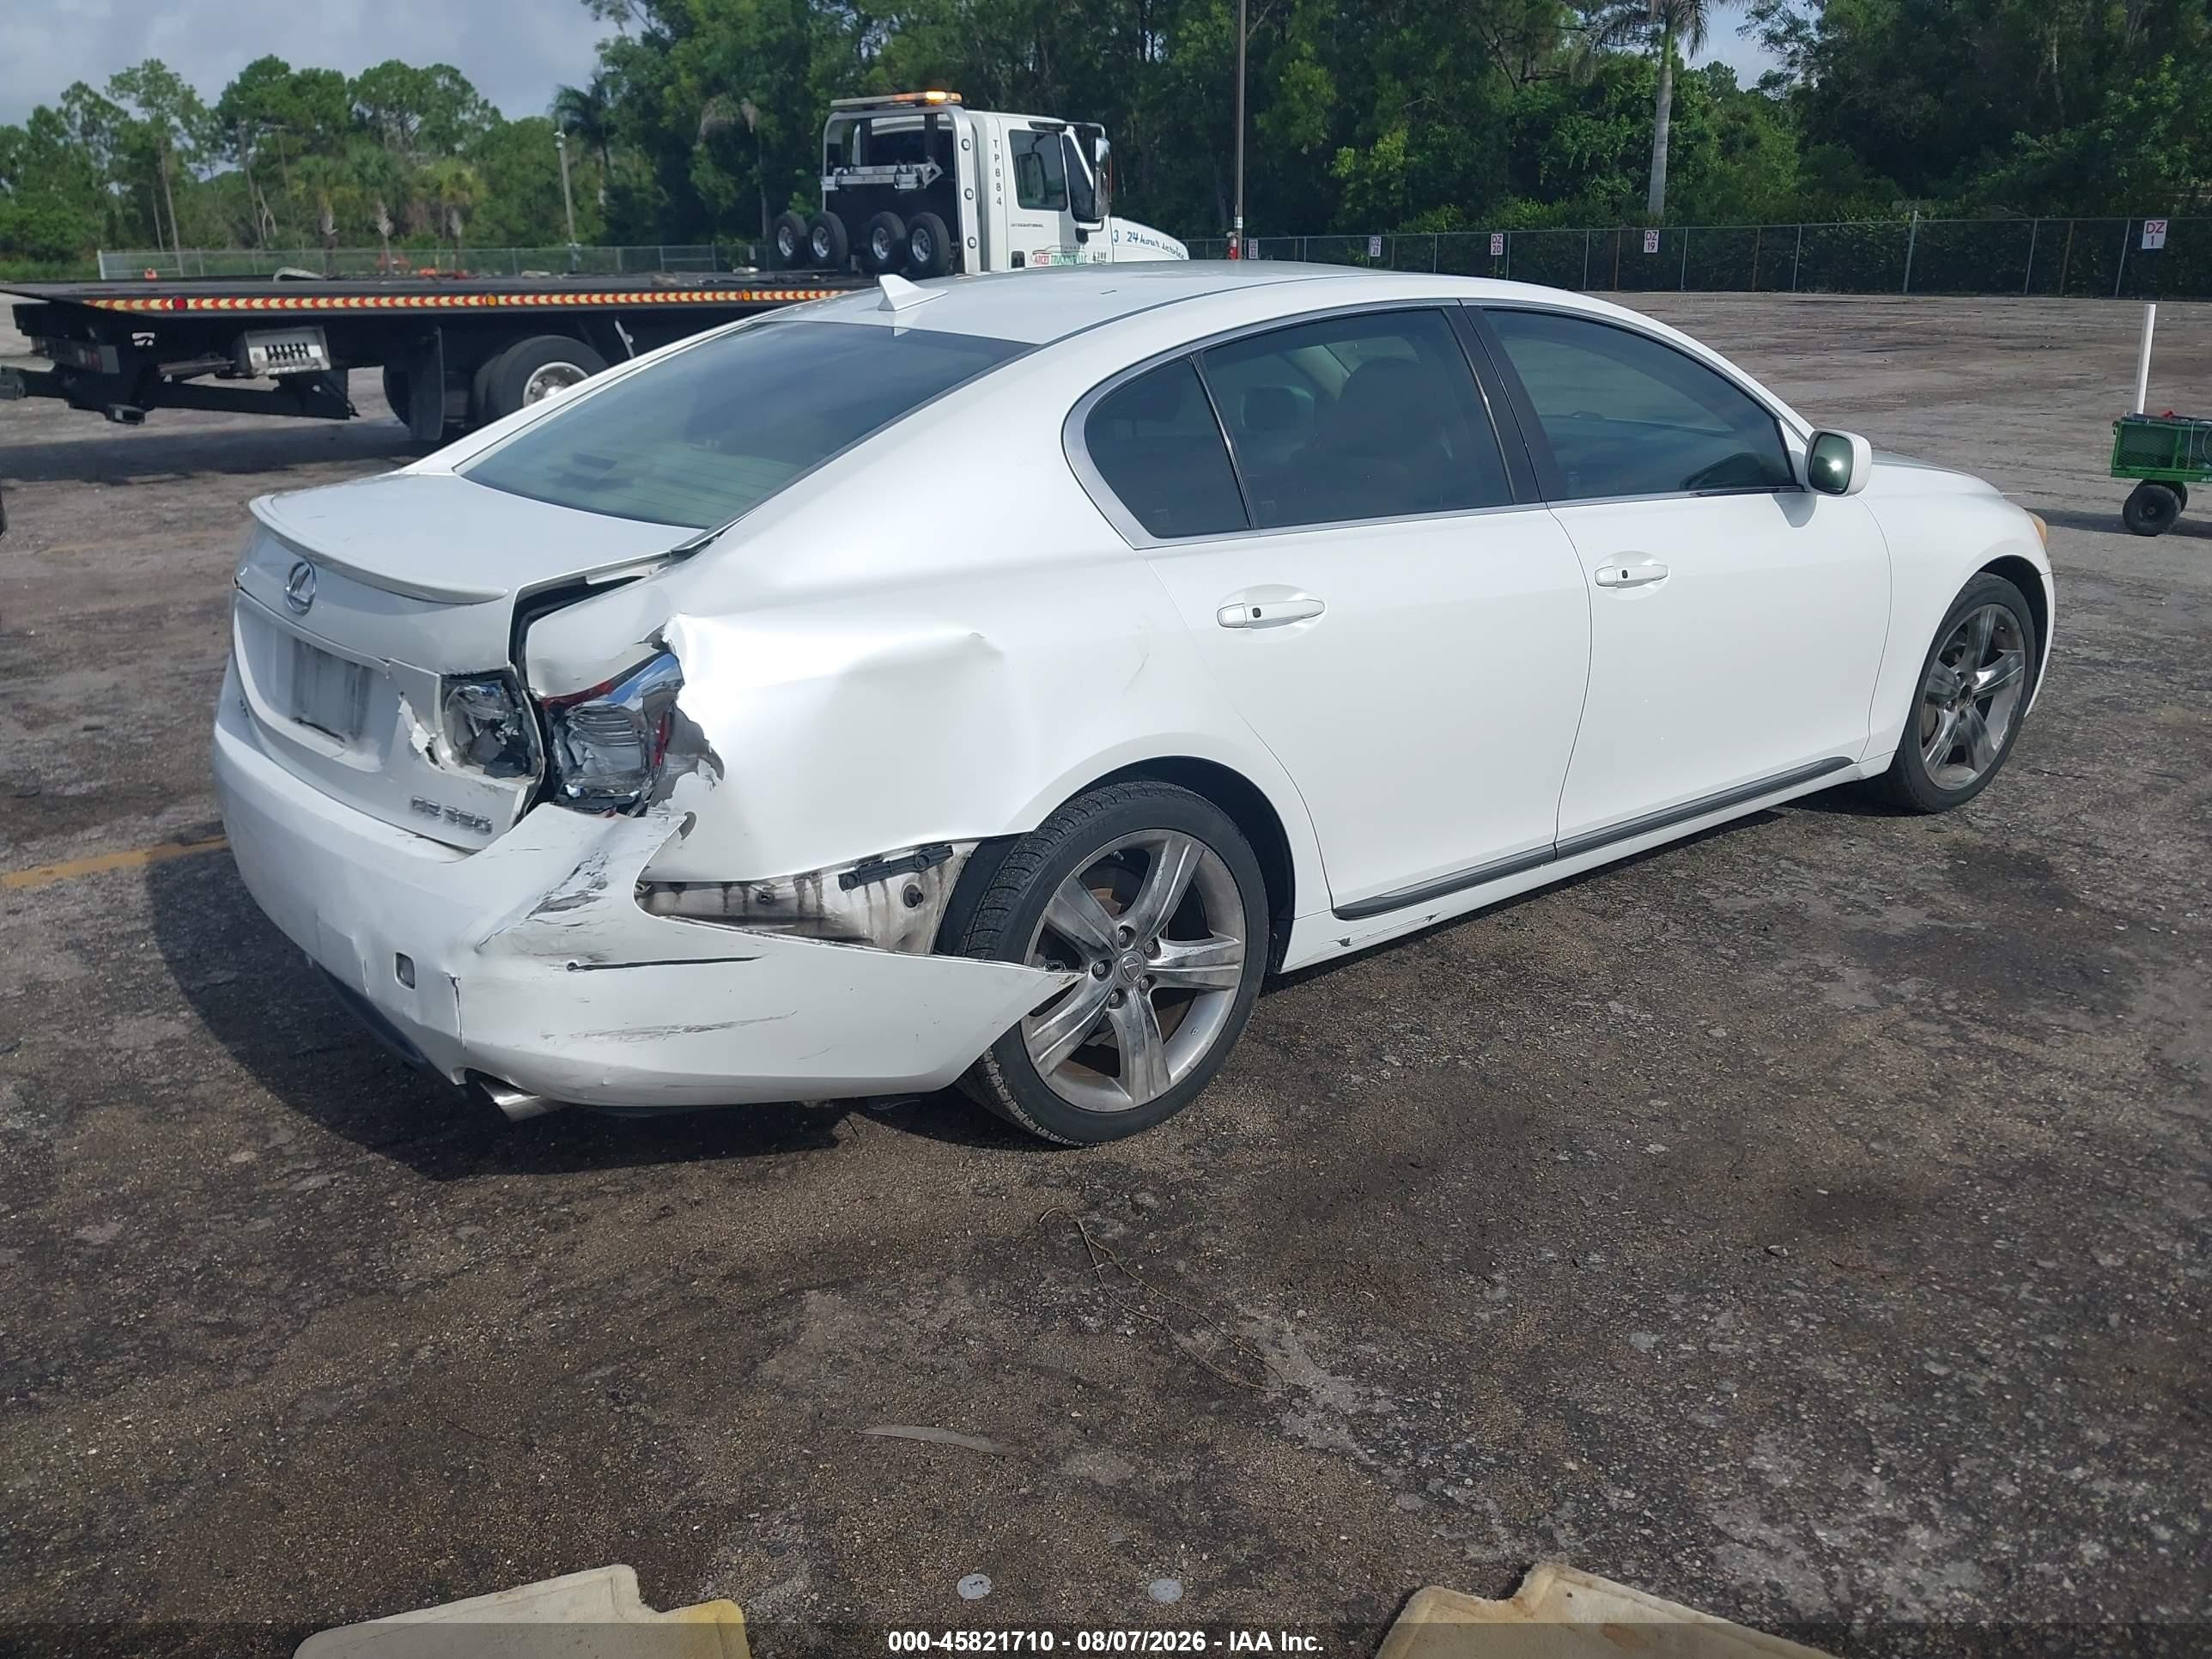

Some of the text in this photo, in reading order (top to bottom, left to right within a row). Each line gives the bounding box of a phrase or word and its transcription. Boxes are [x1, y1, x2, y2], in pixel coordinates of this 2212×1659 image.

[2146, 222, 2166, 234] DZ
[1127, 230, 1139, 243] 24
[1139, 234, 1160, 247] hour
[1492, 235, 1503, 244] DZ
[1646, 231, 1658, 241] DZ
[2150, 235, 2154, 246] 1
[1492, 245, 1502, 253] 20
[1648, 241, 1656, 252] 19
